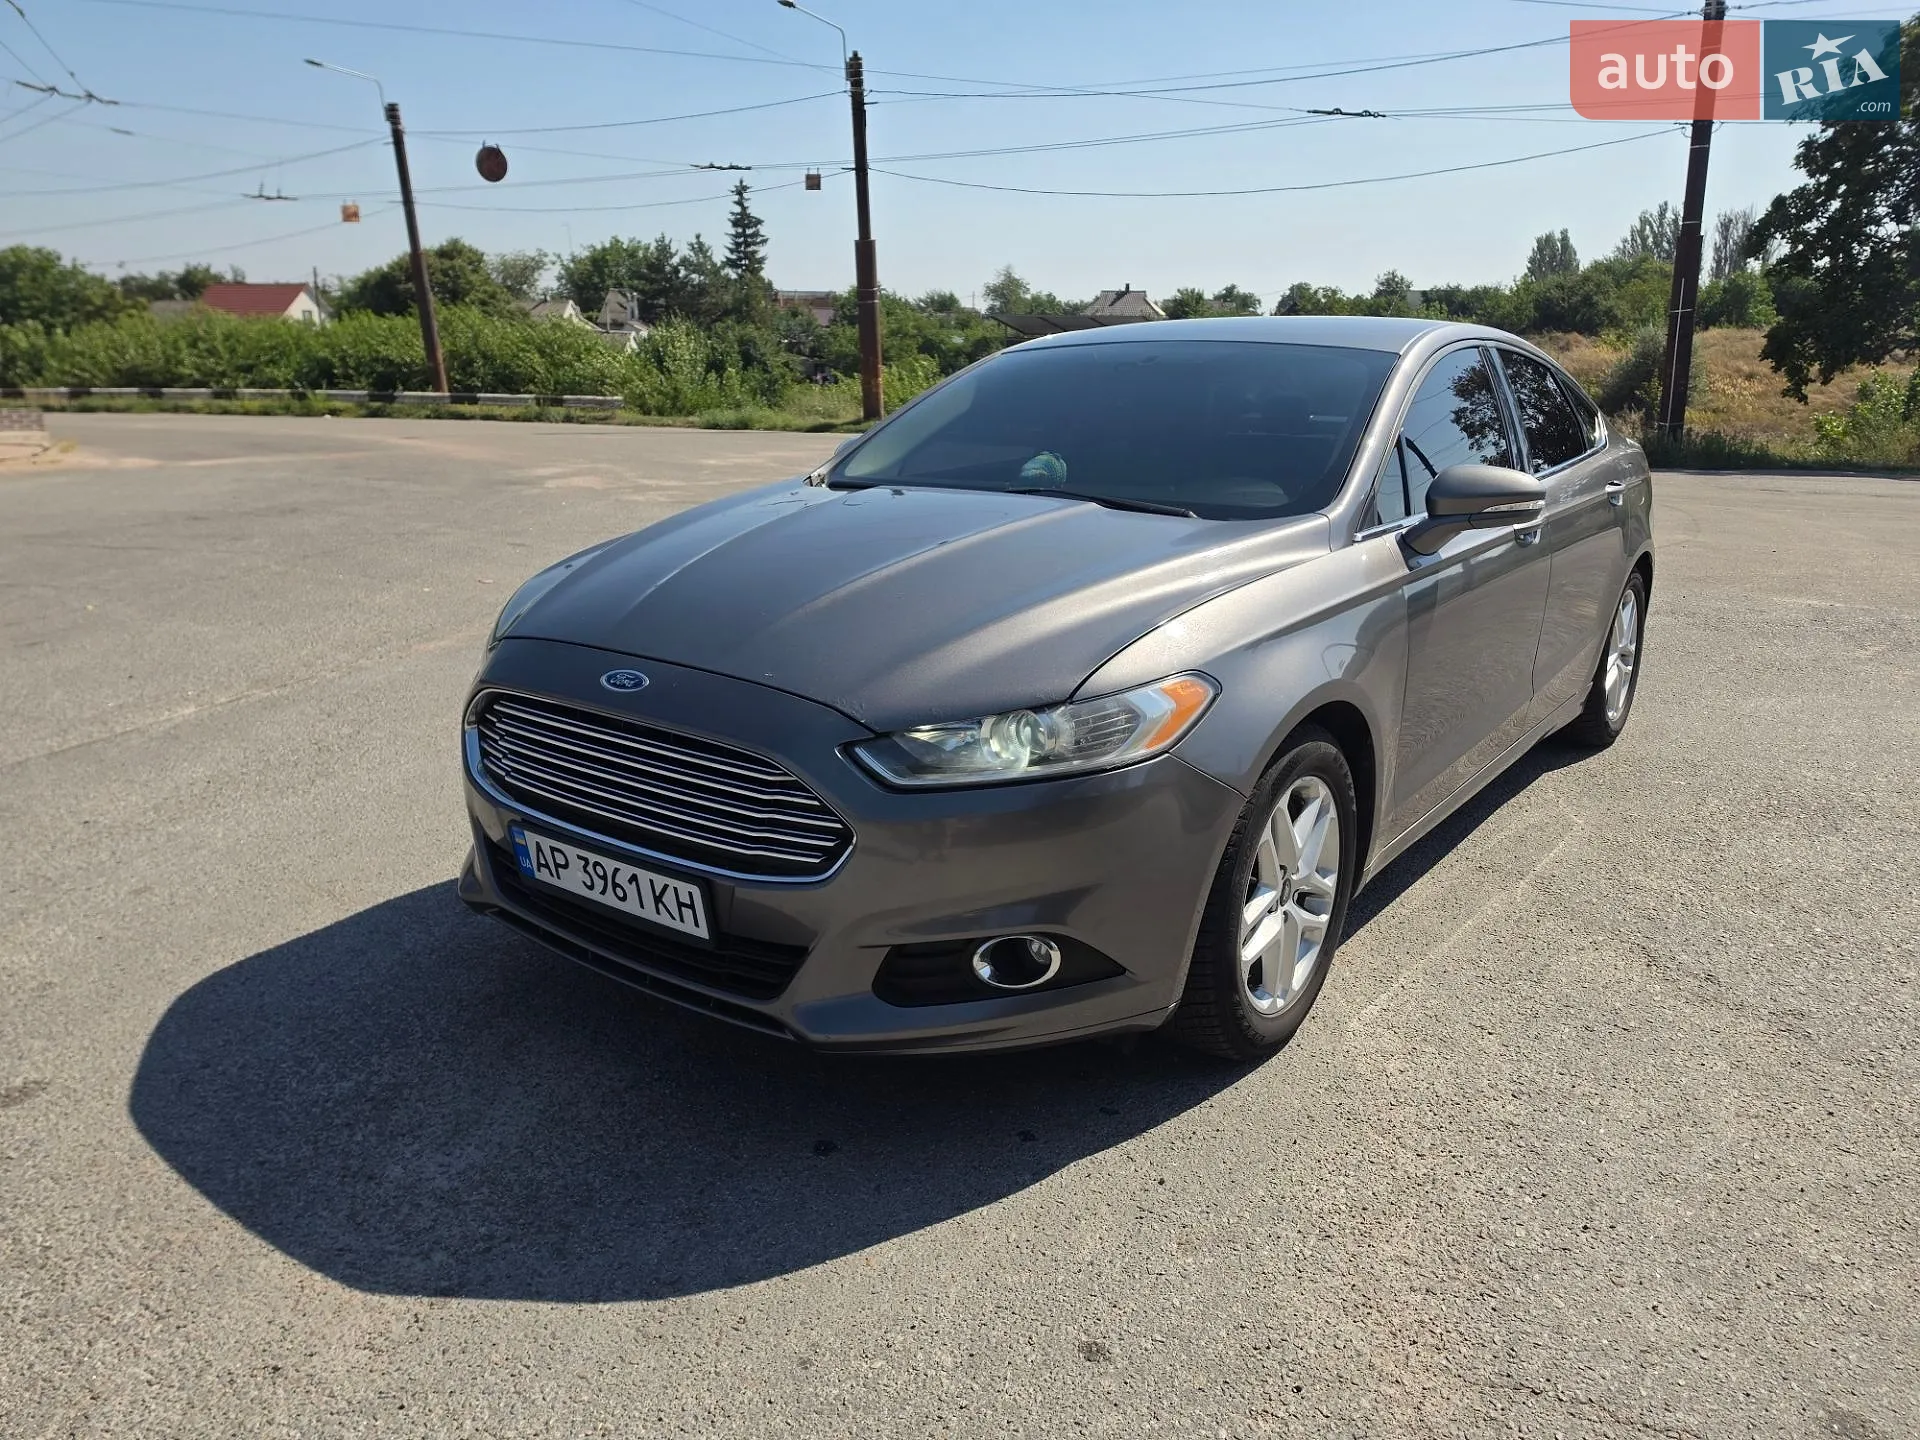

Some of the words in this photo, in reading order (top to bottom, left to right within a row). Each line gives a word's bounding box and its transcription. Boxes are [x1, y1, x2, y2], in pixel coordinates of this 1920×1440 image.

[520, 855, 533, 870] UA
[535, 840, 570, 880] AP
[576, 853, 645, 910] 3961
